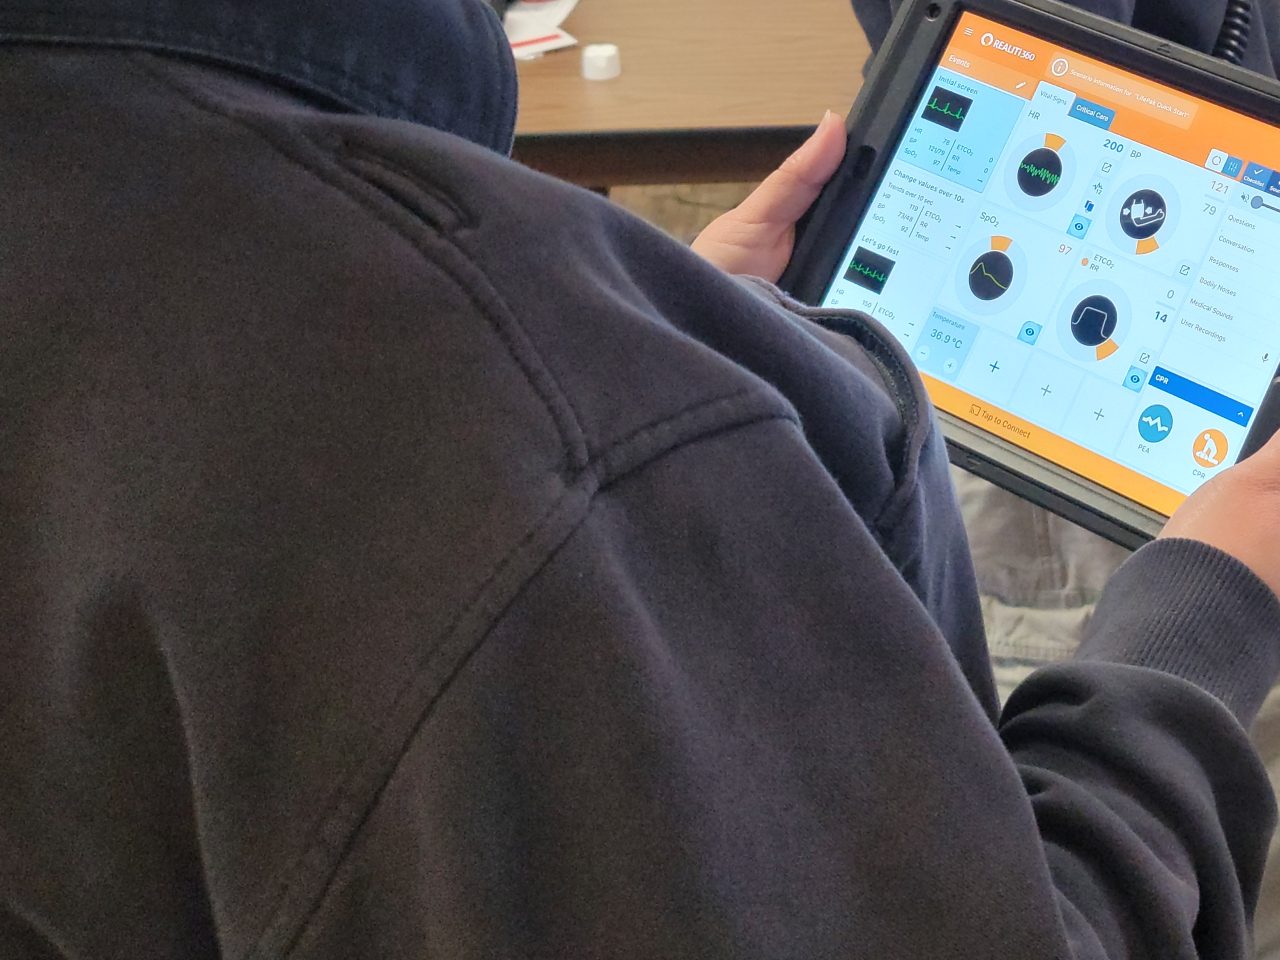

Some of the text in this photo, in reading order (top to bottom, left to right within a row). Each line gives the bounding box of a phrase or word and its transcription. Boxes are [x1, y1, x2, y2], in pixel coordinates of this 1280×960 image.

[993, 39, 1036, 61] REALITI360
[948, 54, 970, 68] Events
[938, 74, 979, 96] Initial screen
[1070, 68, 1093, 82] Scenario
[1093, 78, 1124, 94] information
[1123, 88, 1133, 97] for
[1156, 100, 1172, 113] Quick
[1040, 90, 1067, 107] Vital Signs
[1028, 110, 1041, 121] HR
[1076, 104, 1110, 123] Critical Care
[914, 127, 923, 135] HR
[943, 138, 950, 146] 78
[1103, 138, 1124, 154] 200
[928, 144, 946, 157] 121/79
[1130, 149, 1142, 159] BP
[933, 159, 941, 167] 97
[947, 165, 961, 176] Temp
[893, 169, 966, 203] Change values over 10s
[1210, 180, 1230, 195] 121
[1243, 175, 1265, 188] Checklist
[888, 182, 905, 193] Trends
[905, 191, 918, 199] over
[909, 204, 919, 212] 119
[1202, 203, 1217, 216] 79
[901, 225, 909, 233] 92
[1228, 214, 1257, 230] Questions
[915, 232, 930, 242] Temp
[861, 235, 900, 256] Let's go fast
[1058, 243, 1073, 256] 97
[1218, 235, 1255, 254] Conversation
[1089, 263, 1100, 272] RR
[1208, 255, 1240, 273] Responses
[1199, 276, 1237, 297] Bodily Noises
[1166, 289, 1175, 299] 0
[1154, 310, 1168, 323] 14
[1189, 298, 1234, 321] Medical Sounds
[932, 311, 966, 330] Temperature
[1180, 318, 1226, 343] User Recordings
[930, 328, 963, 349] 36.9 °C
[1155, 374, 1169, 385] CPR
[981, 409, 1031, 439] Tap to Connect
[1137, 443, 1150, 454] PEA
[1192, 469, 1206, 479] CPR
